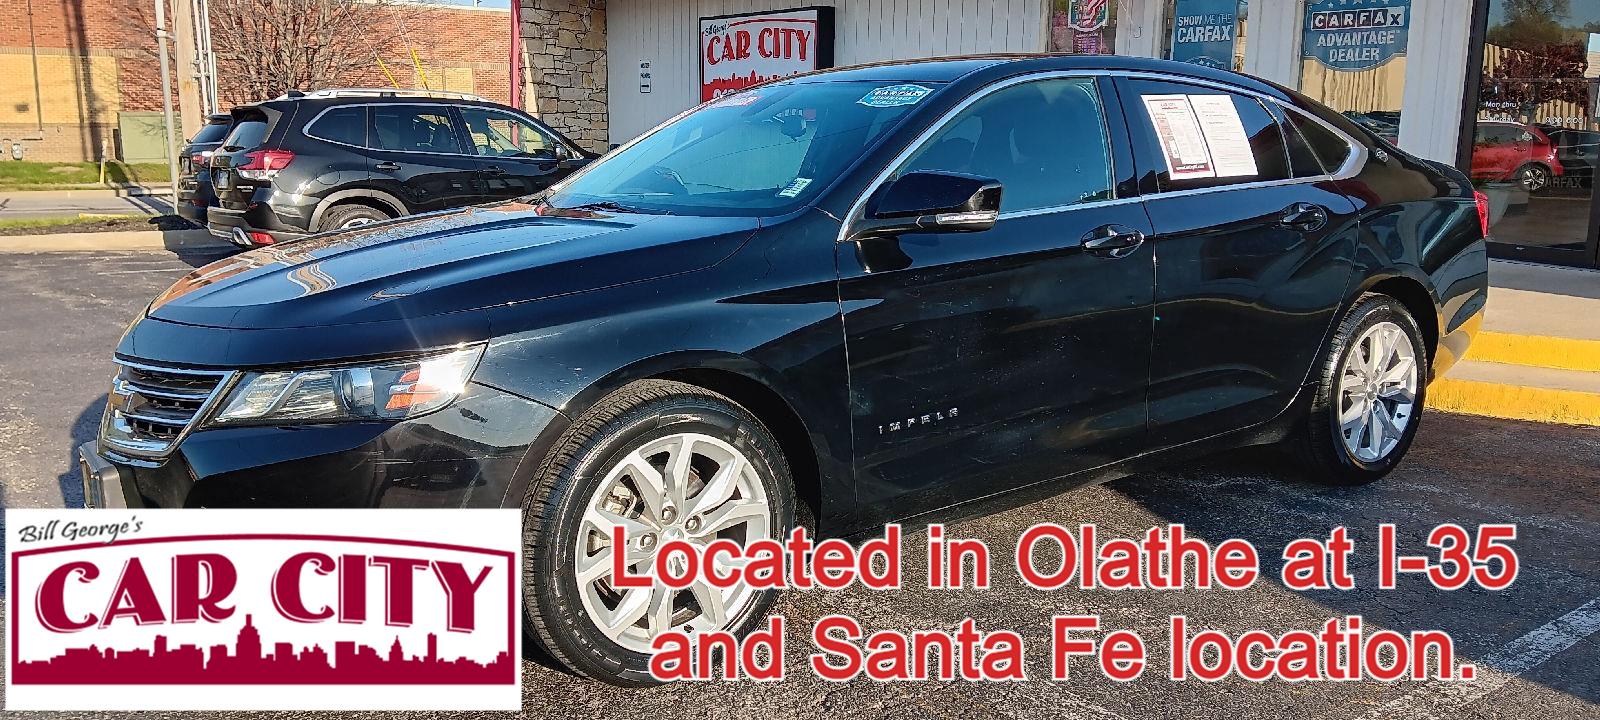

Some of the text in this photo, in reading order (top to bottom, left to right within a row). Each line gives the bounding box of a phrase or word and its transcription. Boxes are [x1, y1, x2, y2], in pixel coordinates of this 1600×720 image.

[1178, 13, 1233, 27] SHOW ME THE
[1314, 11, 1402, 28] CARFAX
[1177, 25, 1233, 43] CARFAX
[1316, 30, 1396, 47] ADVANTAGE
[706, 27, 811, 66] CAR CITY
[1329, 47, 1380, 62] DEALER
